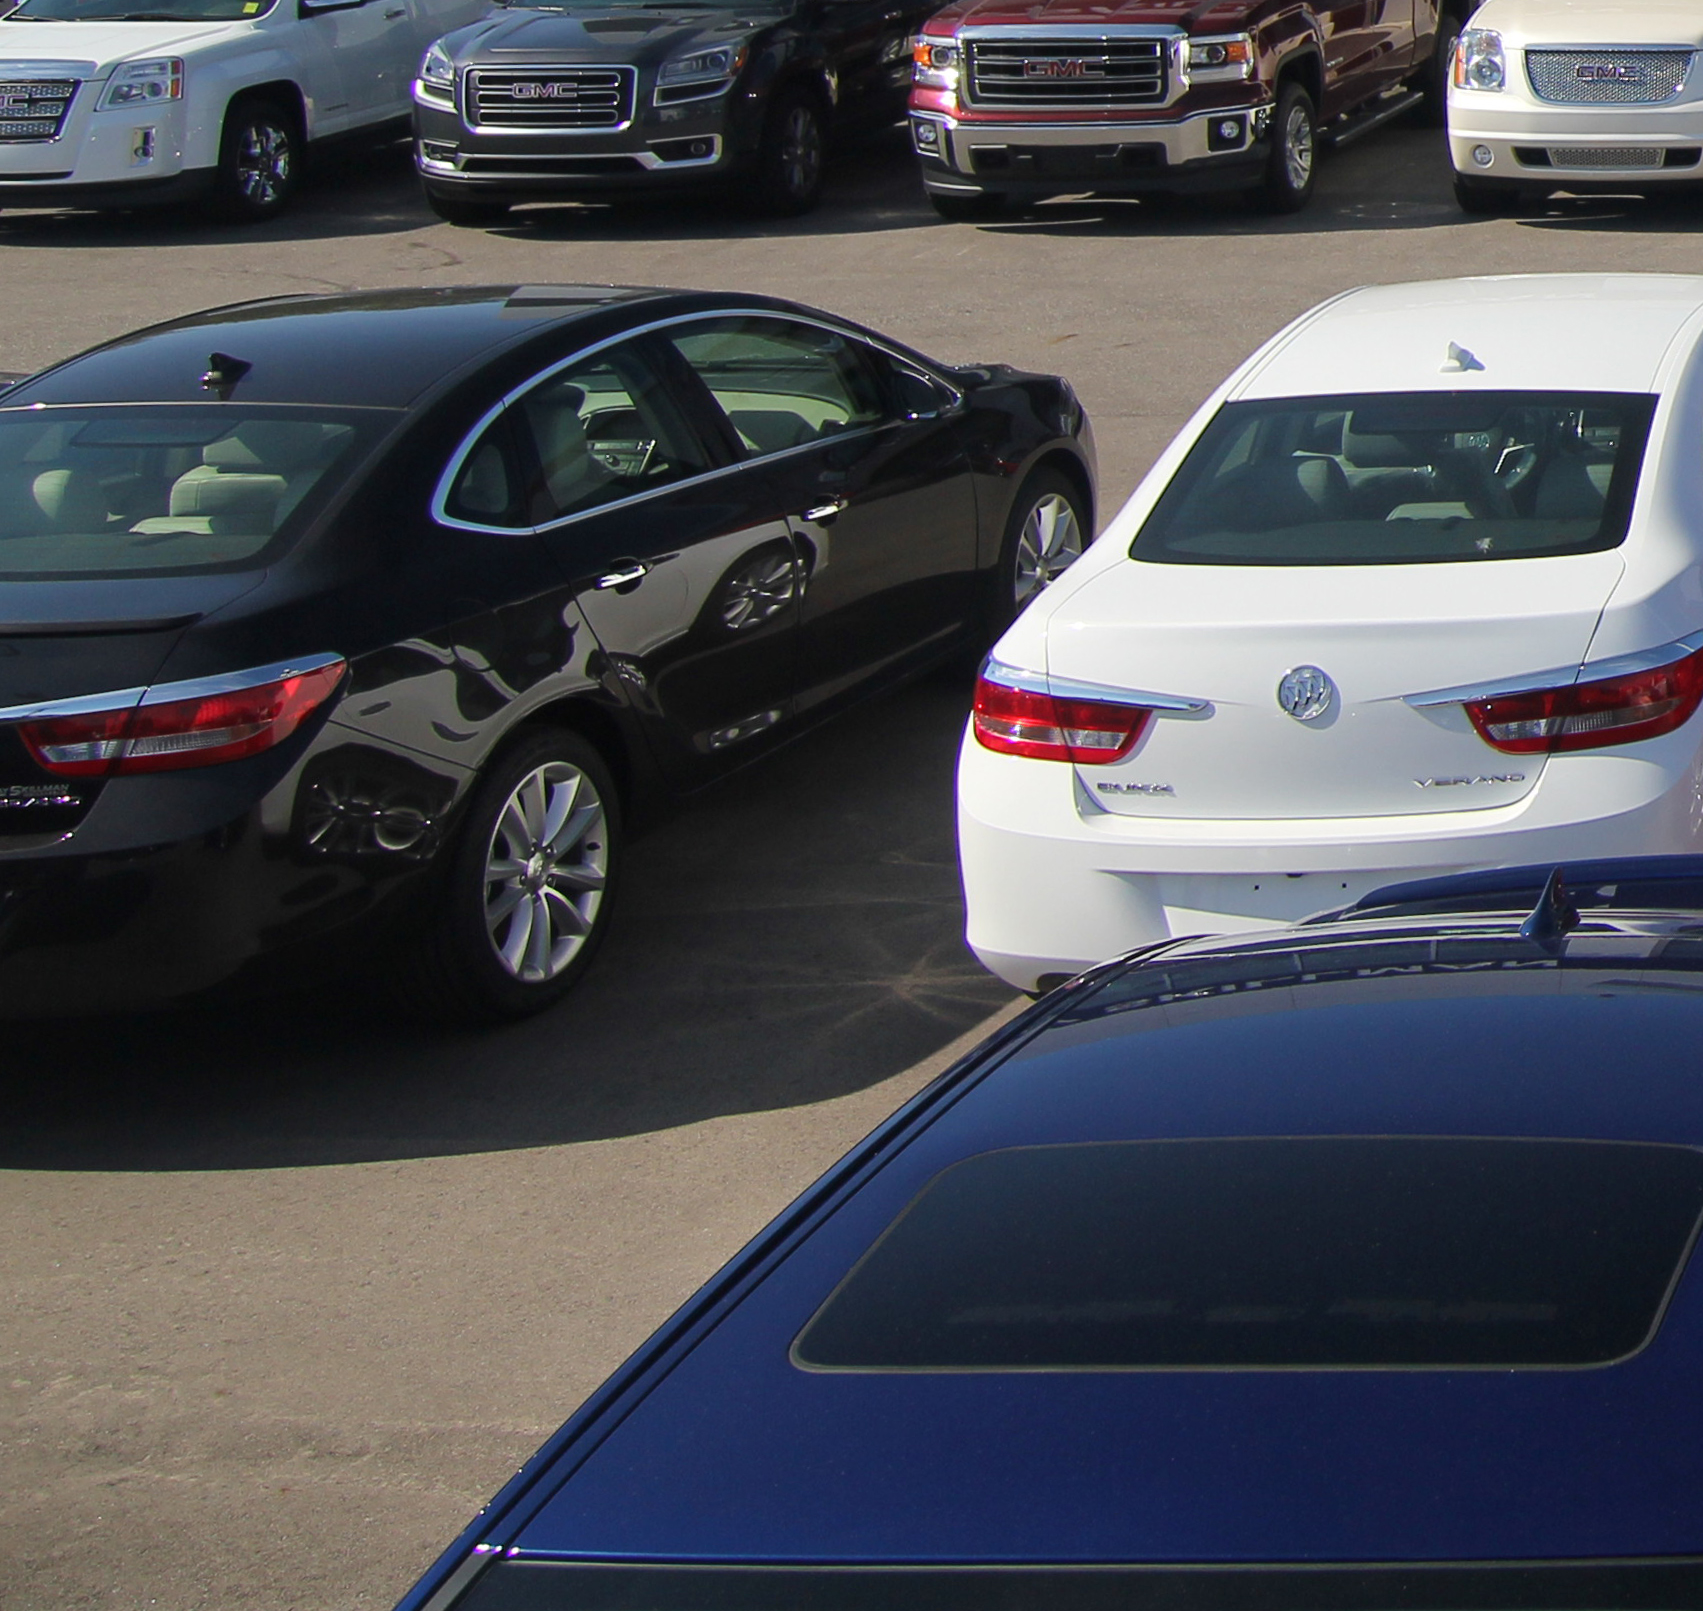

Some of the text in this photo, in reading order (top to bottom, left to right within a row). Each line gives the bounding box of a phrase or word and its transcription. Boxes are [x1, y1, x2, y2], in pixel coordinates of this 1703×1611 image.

[1023, 59, 1105, 77] GMC
[1575, 64, 1638, 80] GMC
[513, 83, 578, 98] GMC
[1412, 775, 1525, 789] VERANO
